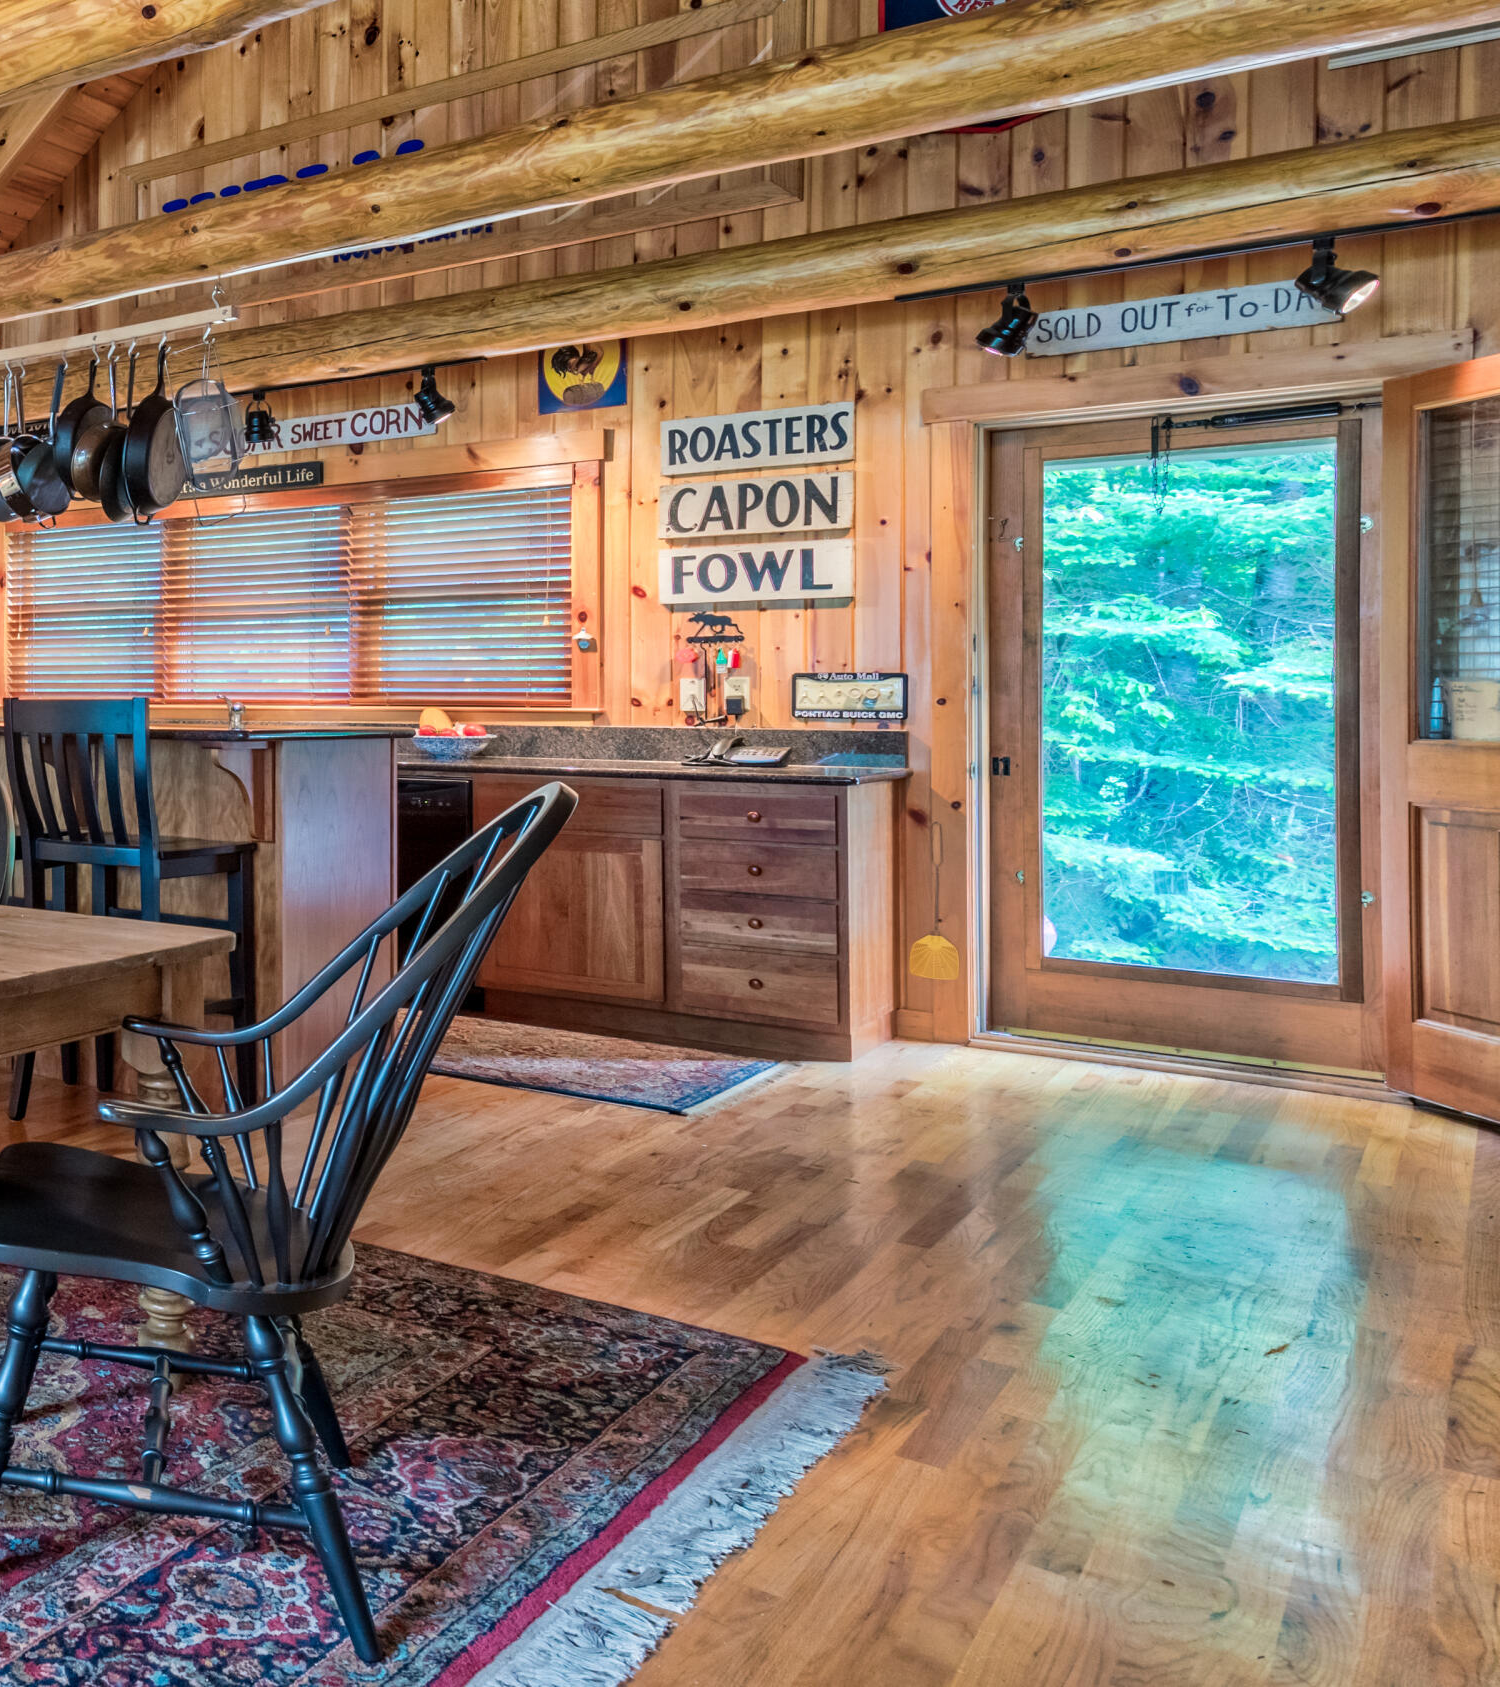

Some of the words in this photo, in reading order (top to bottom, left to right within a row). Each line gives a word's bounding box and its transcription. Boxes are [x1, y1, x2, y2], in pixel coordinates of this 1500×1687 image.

[1036, 311, 1101, 343] SOLD
[1121, 301, 1180, 333] OUT
[1184, 303, 1214, 318] for
[290, 418, 347, 445] SWEET
[350, 405, 423, 438] CORN
[668, 410, 850, 466] ROASTERS
[210, 471, 282, 490] Wonderful
[286, 468, 314, 483] Life
[668, 476, 839, 534] CAPON
[671, 548, 834, 595] FOWL
[830, 672, 854, 681] Auto
[856, 672, 880, 681] Mall
[794, 710, 841, 719] PONTIAC
[842, 711, 877, 719] BUICK
[878, 711, 904, 719] GMC
